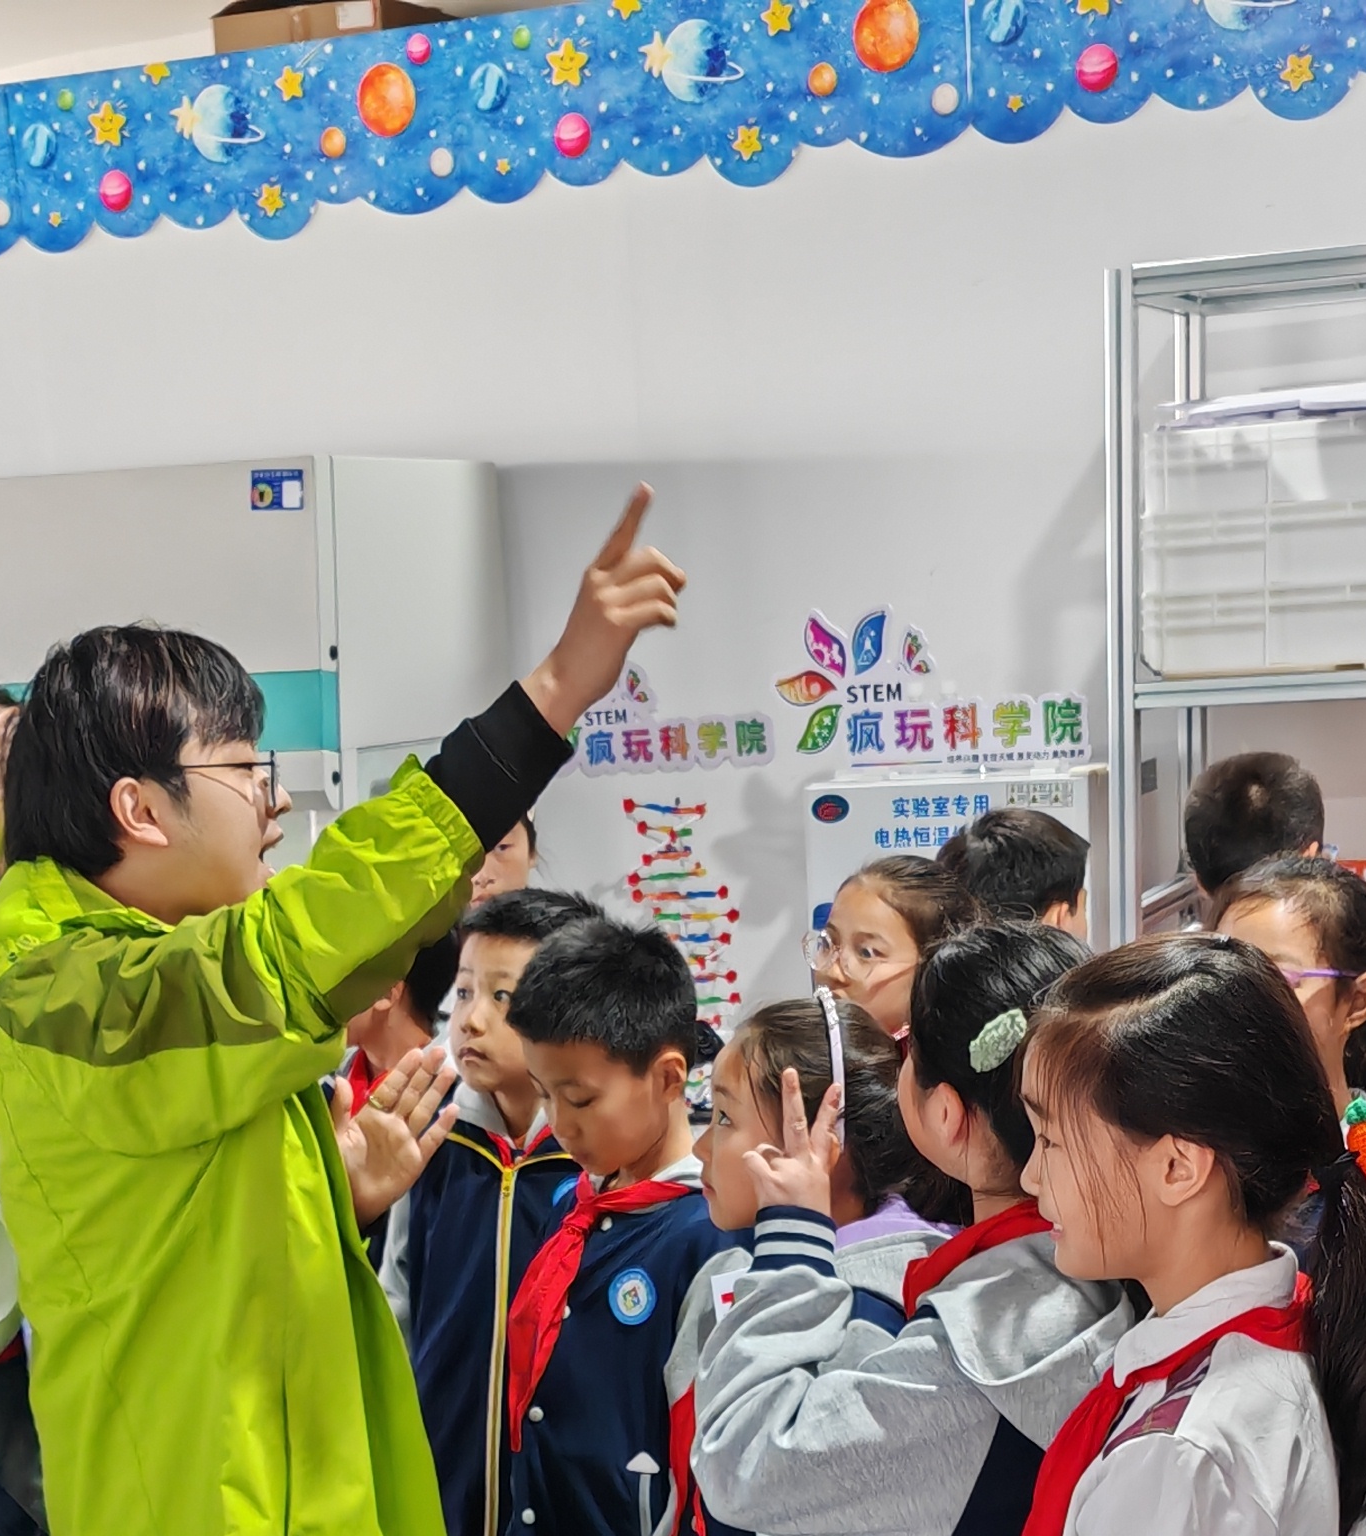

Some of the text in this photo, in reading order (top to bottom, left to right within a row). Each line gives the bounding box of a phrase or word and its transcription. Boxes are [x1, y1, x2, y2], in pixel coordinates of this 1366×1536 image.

[846, 681, 902, 704] STEM
[584, 708, 628, 727] STEM
[846, 697, 1084, 757] 疯玩科学院
[585, 718, 768, 768] 疯玩科学院
[892, 794, 990, 818] 实验室专用
[874, 824, 965, 848] 电热恒温
